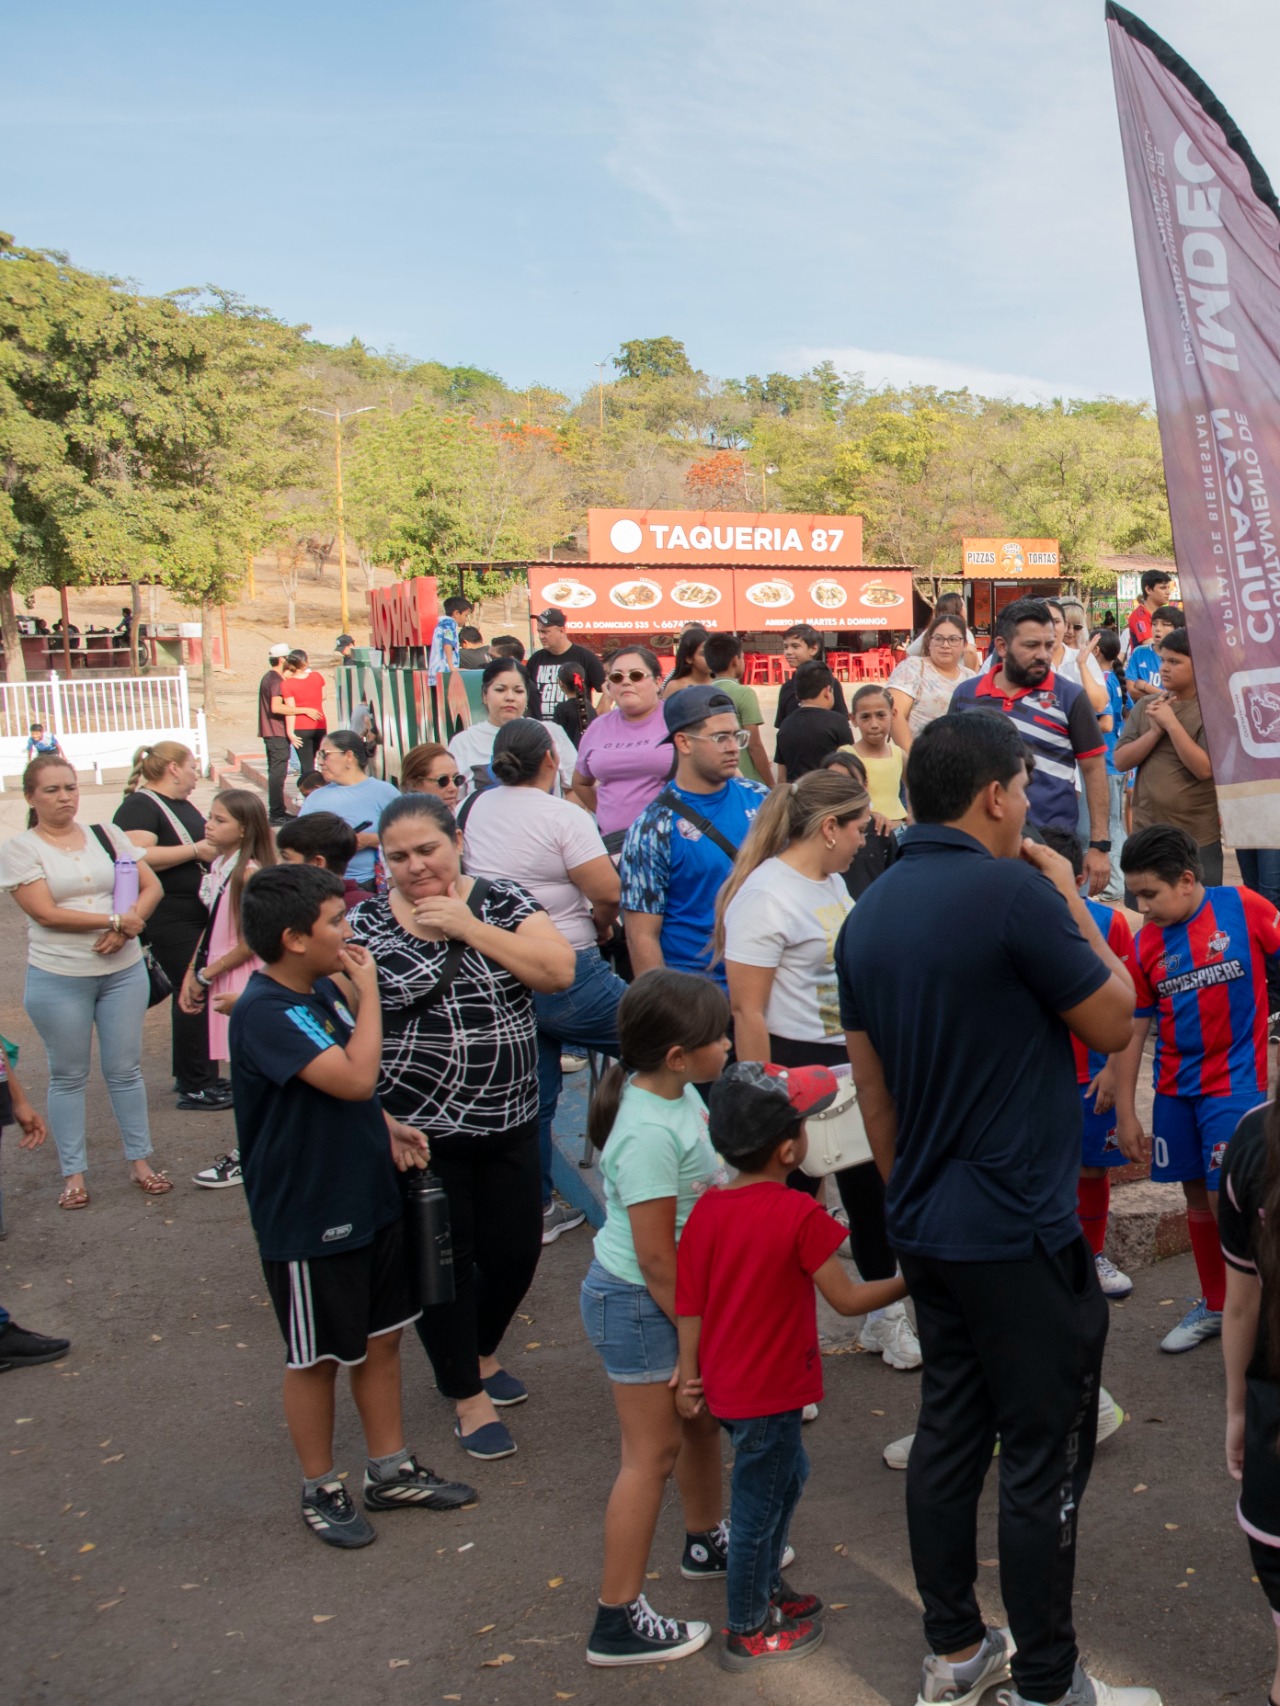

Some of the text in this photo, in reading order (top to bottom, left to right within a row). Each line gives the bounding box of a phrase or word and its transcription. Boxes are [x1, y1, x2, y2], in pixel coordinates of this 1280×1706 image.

[650, 524, 844, 552] TAQUERIA 87
[967, 552, 995, 564] PIZZAS
[1028, 553, 1057, 564] TORTAS
[585, 621, 592, 629] A
[593, 621, 634, 629] DOMICILIO
[661, 620, 718, 629] 6674734
[806, 618, 837, 626] MARTES
[839, 618, 845, 626] A
[847, 617, 888, 626] DOMINGO
